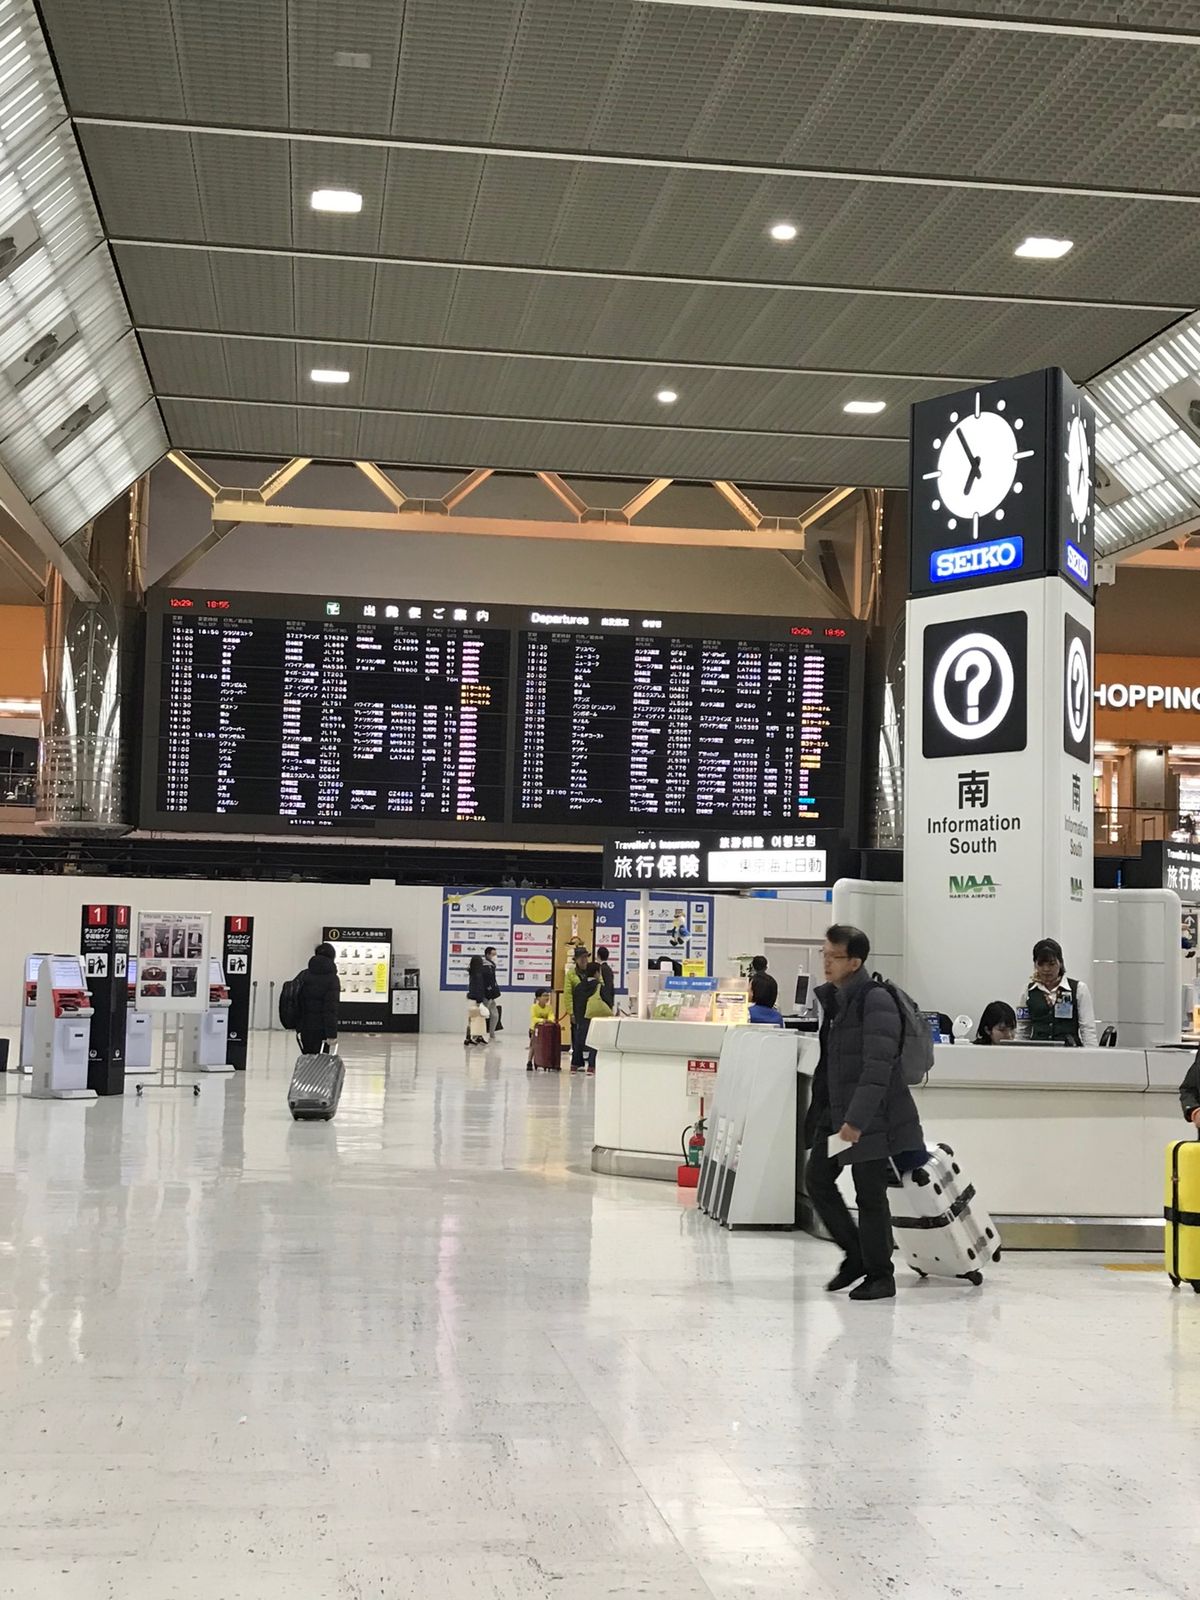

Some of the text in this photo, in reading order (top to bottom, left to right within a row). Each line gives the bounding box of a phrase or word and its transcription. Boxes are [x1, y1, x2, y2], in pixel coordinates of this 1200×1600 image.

[936, 543, 1016, 576] SEIKO
[531, 612, 590, 625] Departures
[958, 770, 990, 810] 南
[928, 816, 1020, 834] Information
[950, 837, 997, 854] South
[614, 854, 700, 878] 旅行保険
[949, 875, 999, 893] NAA
[94, 908, 101, 922] 1
[120, 908, 125, 922] 1
[235, 918, 242, 929] 1
